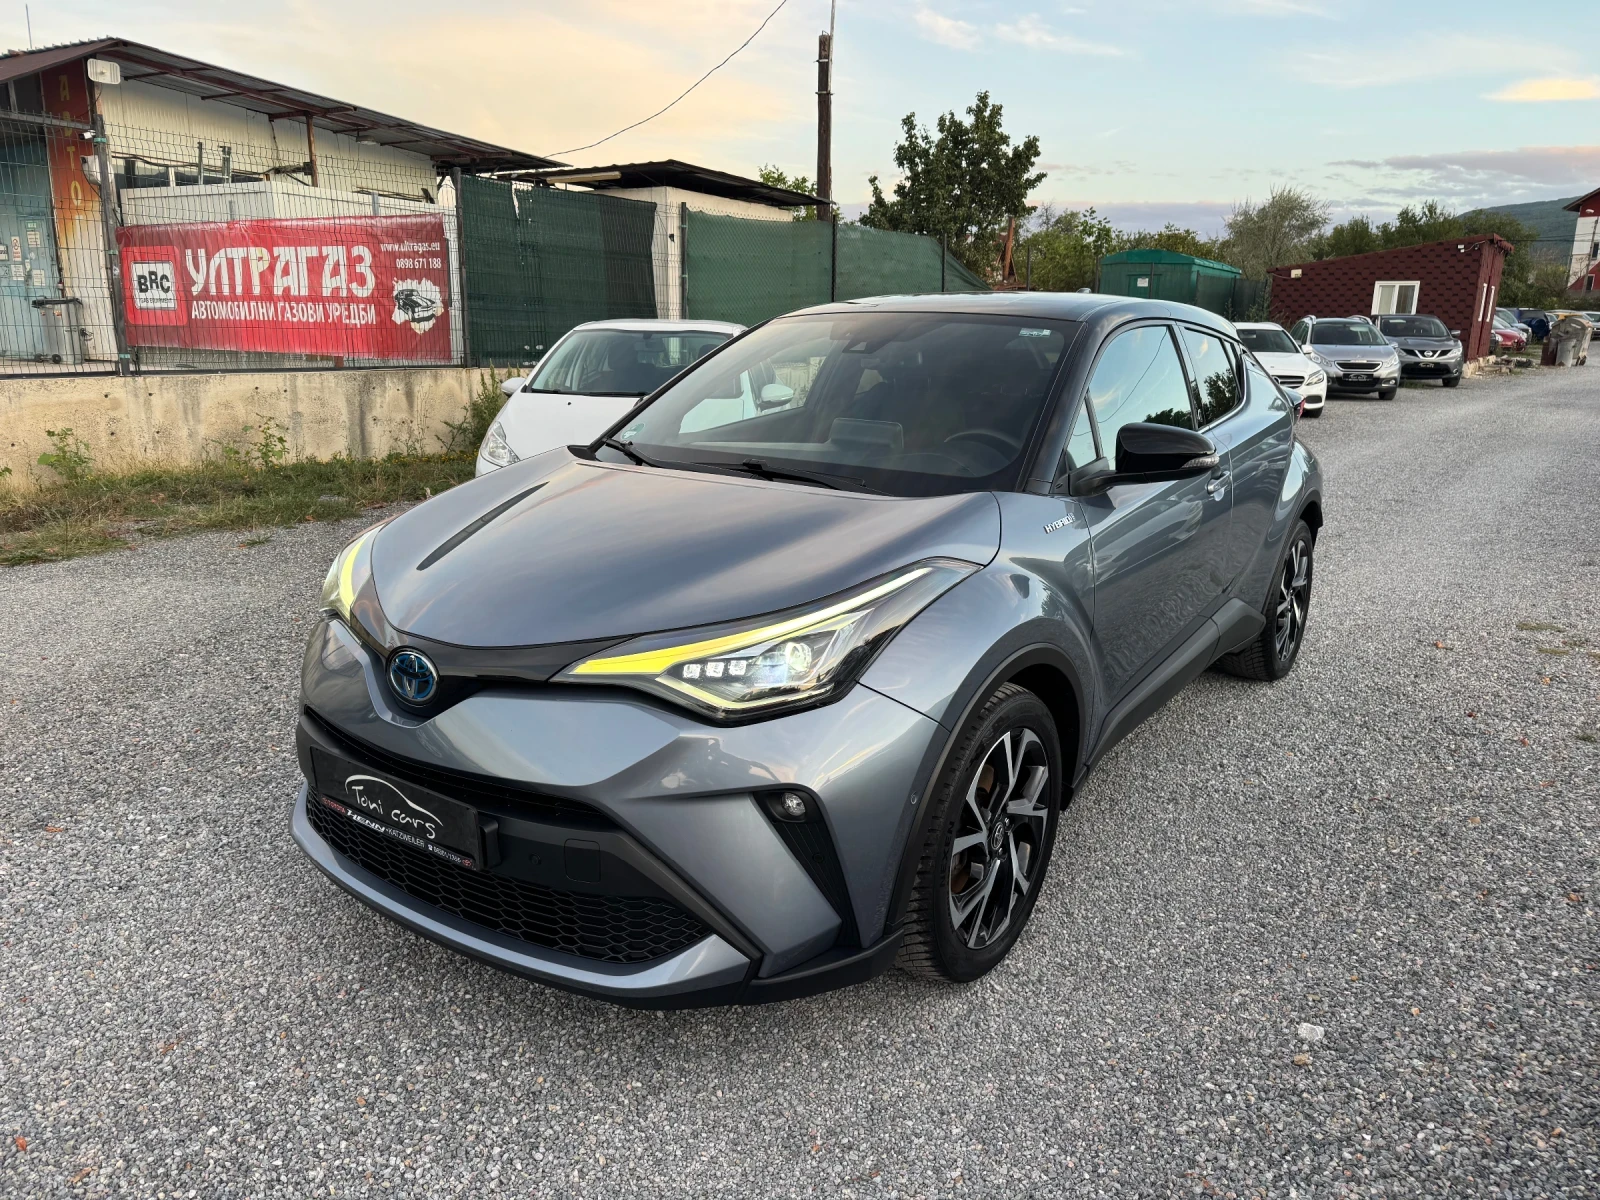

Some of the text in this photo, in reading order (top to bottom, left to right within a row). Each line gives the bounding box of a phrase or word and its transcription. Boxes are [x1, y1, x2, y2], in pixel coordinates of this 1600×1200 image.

[380, 240, 441, 254] www.ultragas.eu
[185, 245, 376, 298] УЛТРАГАЗ
[395, 257, 442, 269] 0898 671 188
[137, 270, 171, 294] BRC
[191, 301, 377, 328] АВТОМОБИЛНИ ГАЗОВИ УРЕДБИ
[351, 785, 436, 839] Toni cars
